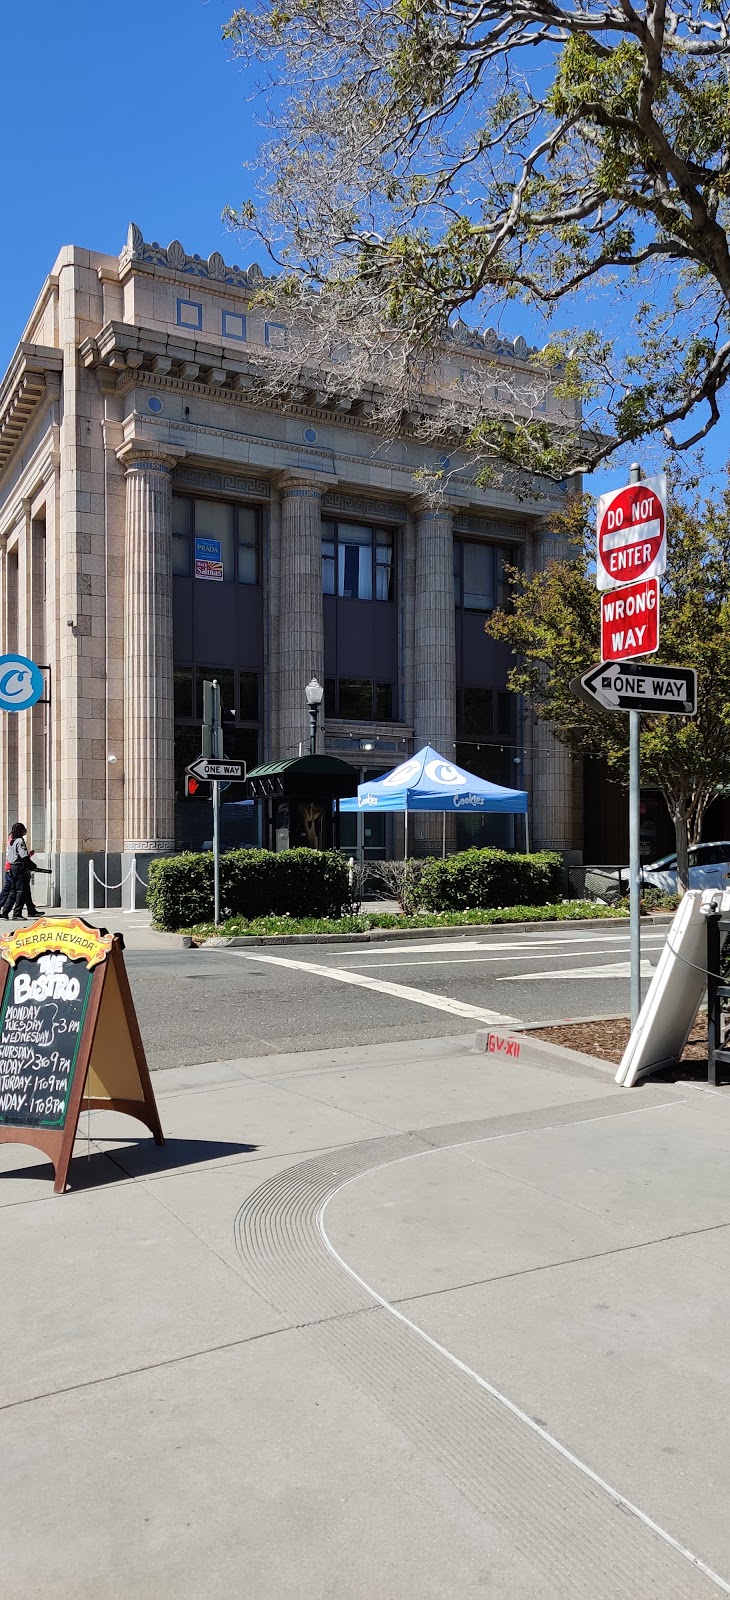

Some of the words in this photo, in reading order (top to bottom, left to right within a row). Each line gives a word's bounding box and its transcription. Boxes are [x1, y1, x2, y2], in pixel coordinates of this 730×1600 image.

[607, 507, 624, 530] DO
[632, 497, 655, 522] NOT
[197, 544, 219, 553] PRADA
[610, 543, 652, 573] ENTER
[197, 566, 222, 576] Salinas
[604, 589, 656, 623] WRONG
[611, 624, 647, 653] WAY
[613, 676, 646, 695] ONE
[652, 680, 685, 698] WAY
[204, 765, 221, 774] ONE
[223, 766, 240, 774] WAY
[452, 793, 485, 808] Cookies
[15, 932, 53, 949] SIERRA
[55, 932, 95, 951] NEVADA
[37, 954, 68, 975] THE
[5, 1005, 41, 1020] MONDAY
[4, 1019, 44, 1032] TUESDAY
[68, 1020, 80, 1033] PM
[2, 1030, 50, 1044] WEDNESDAY
[50, 1051, 59, 1071] 9
[59, 1058, 71, 1073] PM
[55, 1078, 67, 1092] PM
[45, 1096, 54, 1114] 8
